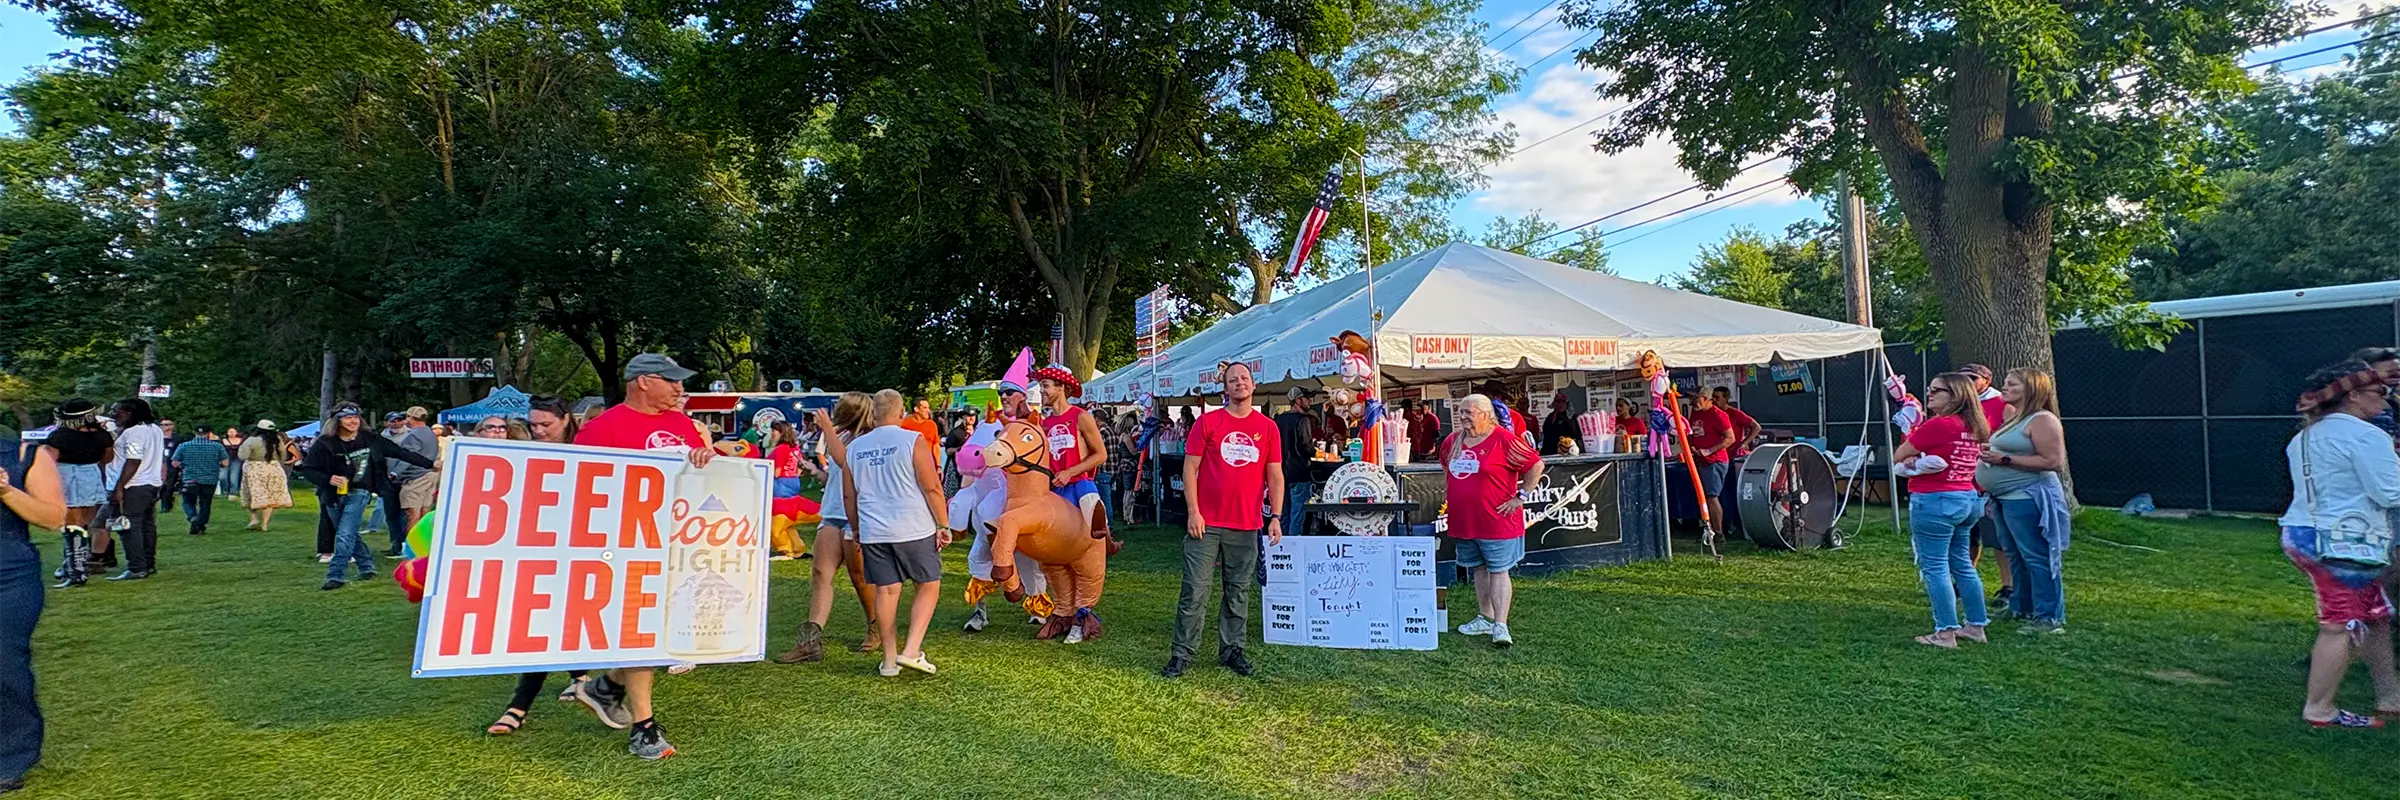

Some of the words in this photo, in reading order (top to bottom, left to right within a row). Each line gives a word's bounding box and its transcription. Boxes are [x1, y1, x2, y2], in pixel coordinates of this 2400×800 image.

[1416, 337, 1441, 354] CASH
[1444, 337, 1470, 354] ONLY
[1568, 339, 1591, 356] CASH
[1593, 339, 1616, 356] ONLY
[1310, 348, 1324, 364] CASH
[1777, 381, 1803, 393] $7.00
[856, 450, 879, 460] SUMMER
[881, 446, 897, 456] CAMP
[455, 454, 665, 549] BEER
[669, 498, 760, 547] Coors
[1523, 506, 1546, 529] The
[1557, 503, 1599, 531] Burg
[1327, 543, 1353, 558] WE
[668, 547, 756, 573] LIGHT
[1307, 562, 1326, 574] HOPE
[438, 559, 662, 656] HERE
[1318, 598, 1362, 617] Tonight
[1276, 613, 1290, 621] FOR
